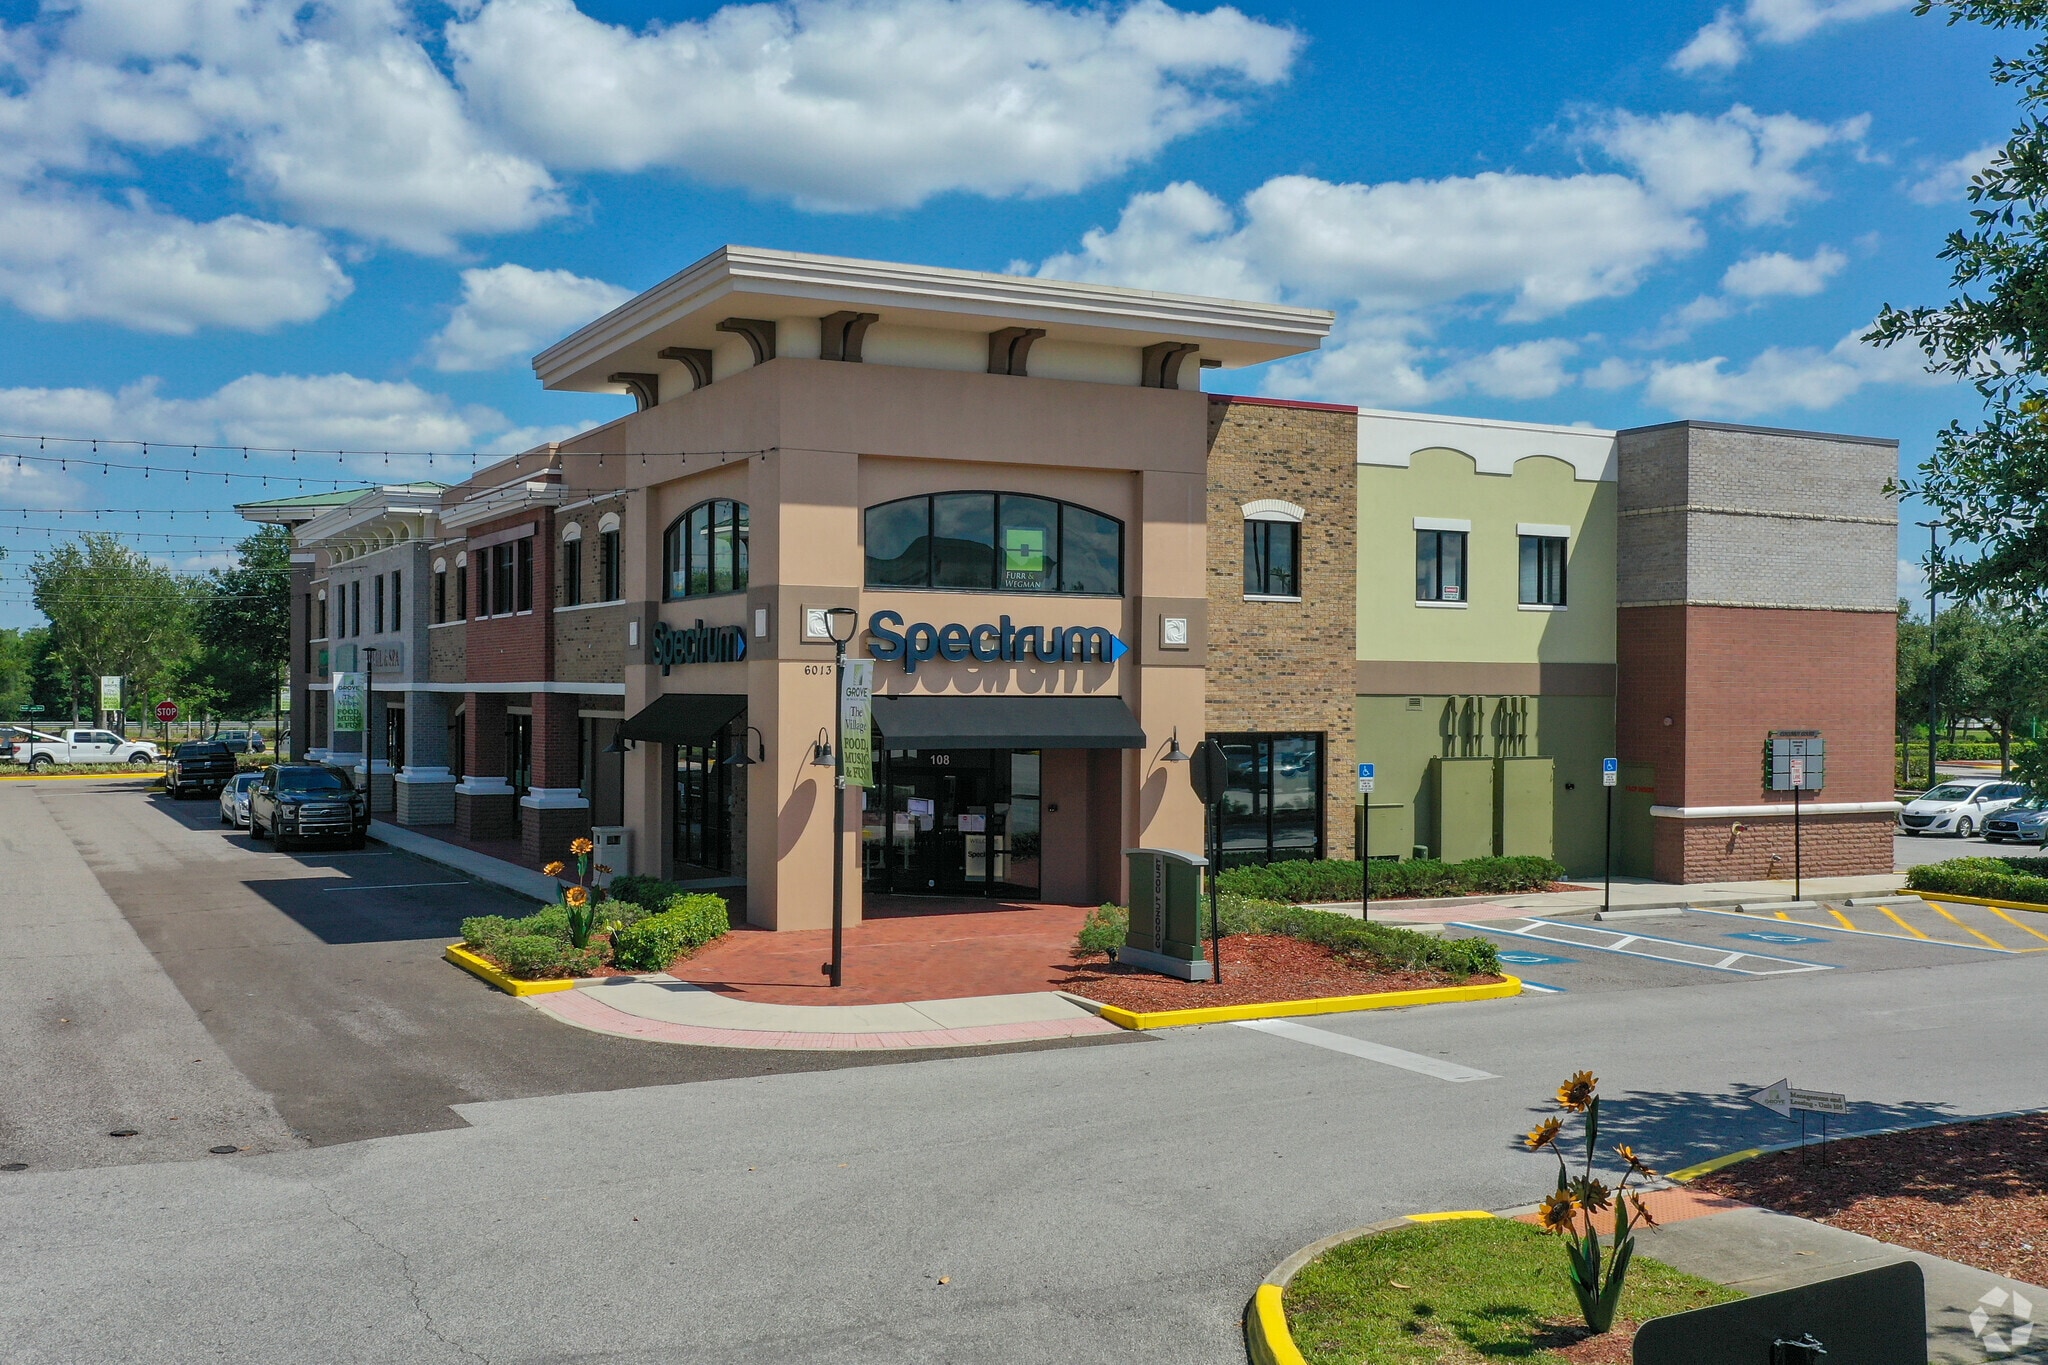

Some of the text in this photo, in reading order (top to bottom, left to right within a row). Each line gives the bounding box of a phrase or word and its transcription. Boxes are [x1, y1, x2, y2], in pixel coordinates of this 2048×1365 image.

[1006, 571, 1034, 580] FURR &
[1005, 580, 1041, 588] WEGMAN
[652, 618, 741, 676] Spectrum
[869, 610, 1113, 675] Spectrum
[804, 665, 832, 675] 6013
[846, 687, 868, 698] GROVE
[156, 707, 177, 716] STOP
[850, 706, 863, 717] The
[845, 719, 867, 734] Village
[844, 738, 869, 752] FOOD,
[845, 752, 869, 765] MUSIC
[930, 754, 950, 766] 108
[846, 767, 870, 779] & FUN
